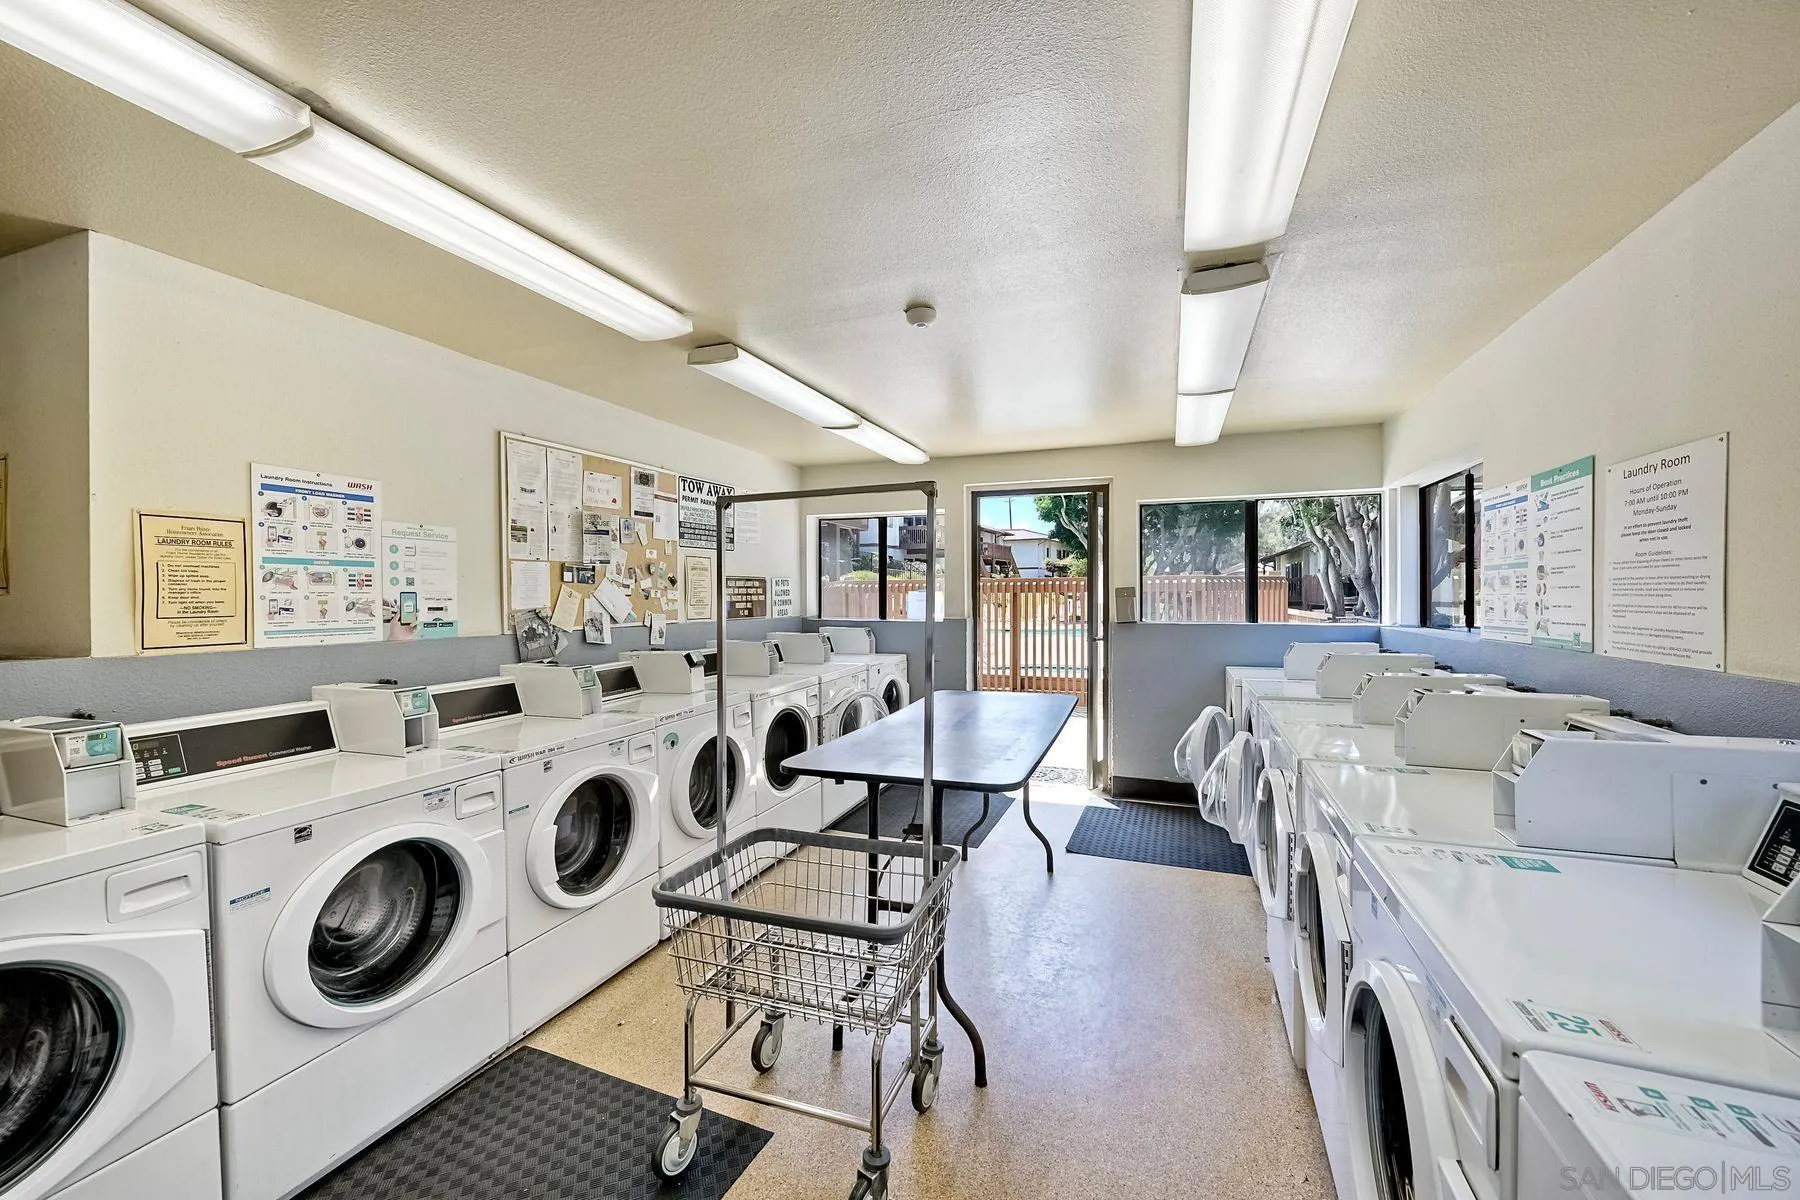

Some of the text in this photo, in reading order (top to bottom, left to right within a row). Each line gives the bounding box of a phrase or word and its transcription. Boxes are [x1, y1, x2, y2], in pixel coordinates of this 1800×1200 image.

[1624, 454, 1690, 479] Laundry Room
[348, 482, 373, 490] WASH
[1541, 469, 1579, 487] Best Practices
[681, 479, 732, 497] TOW AWAY
[1630, 486, 1645, 495] Hours
[1653, 479, 1682, 490] Operation
[1661, 491, 1676, 500] 10:00
[1633, 504, 1677, 516] Monday-Sunday
[392, 529, 420, 538] Request
[423, 531, 448, 539] Service
[216, 758, 242, 766] Speed
[243, 753, 268, 761] Queen
[269, 748, 295, 757] Commercial
